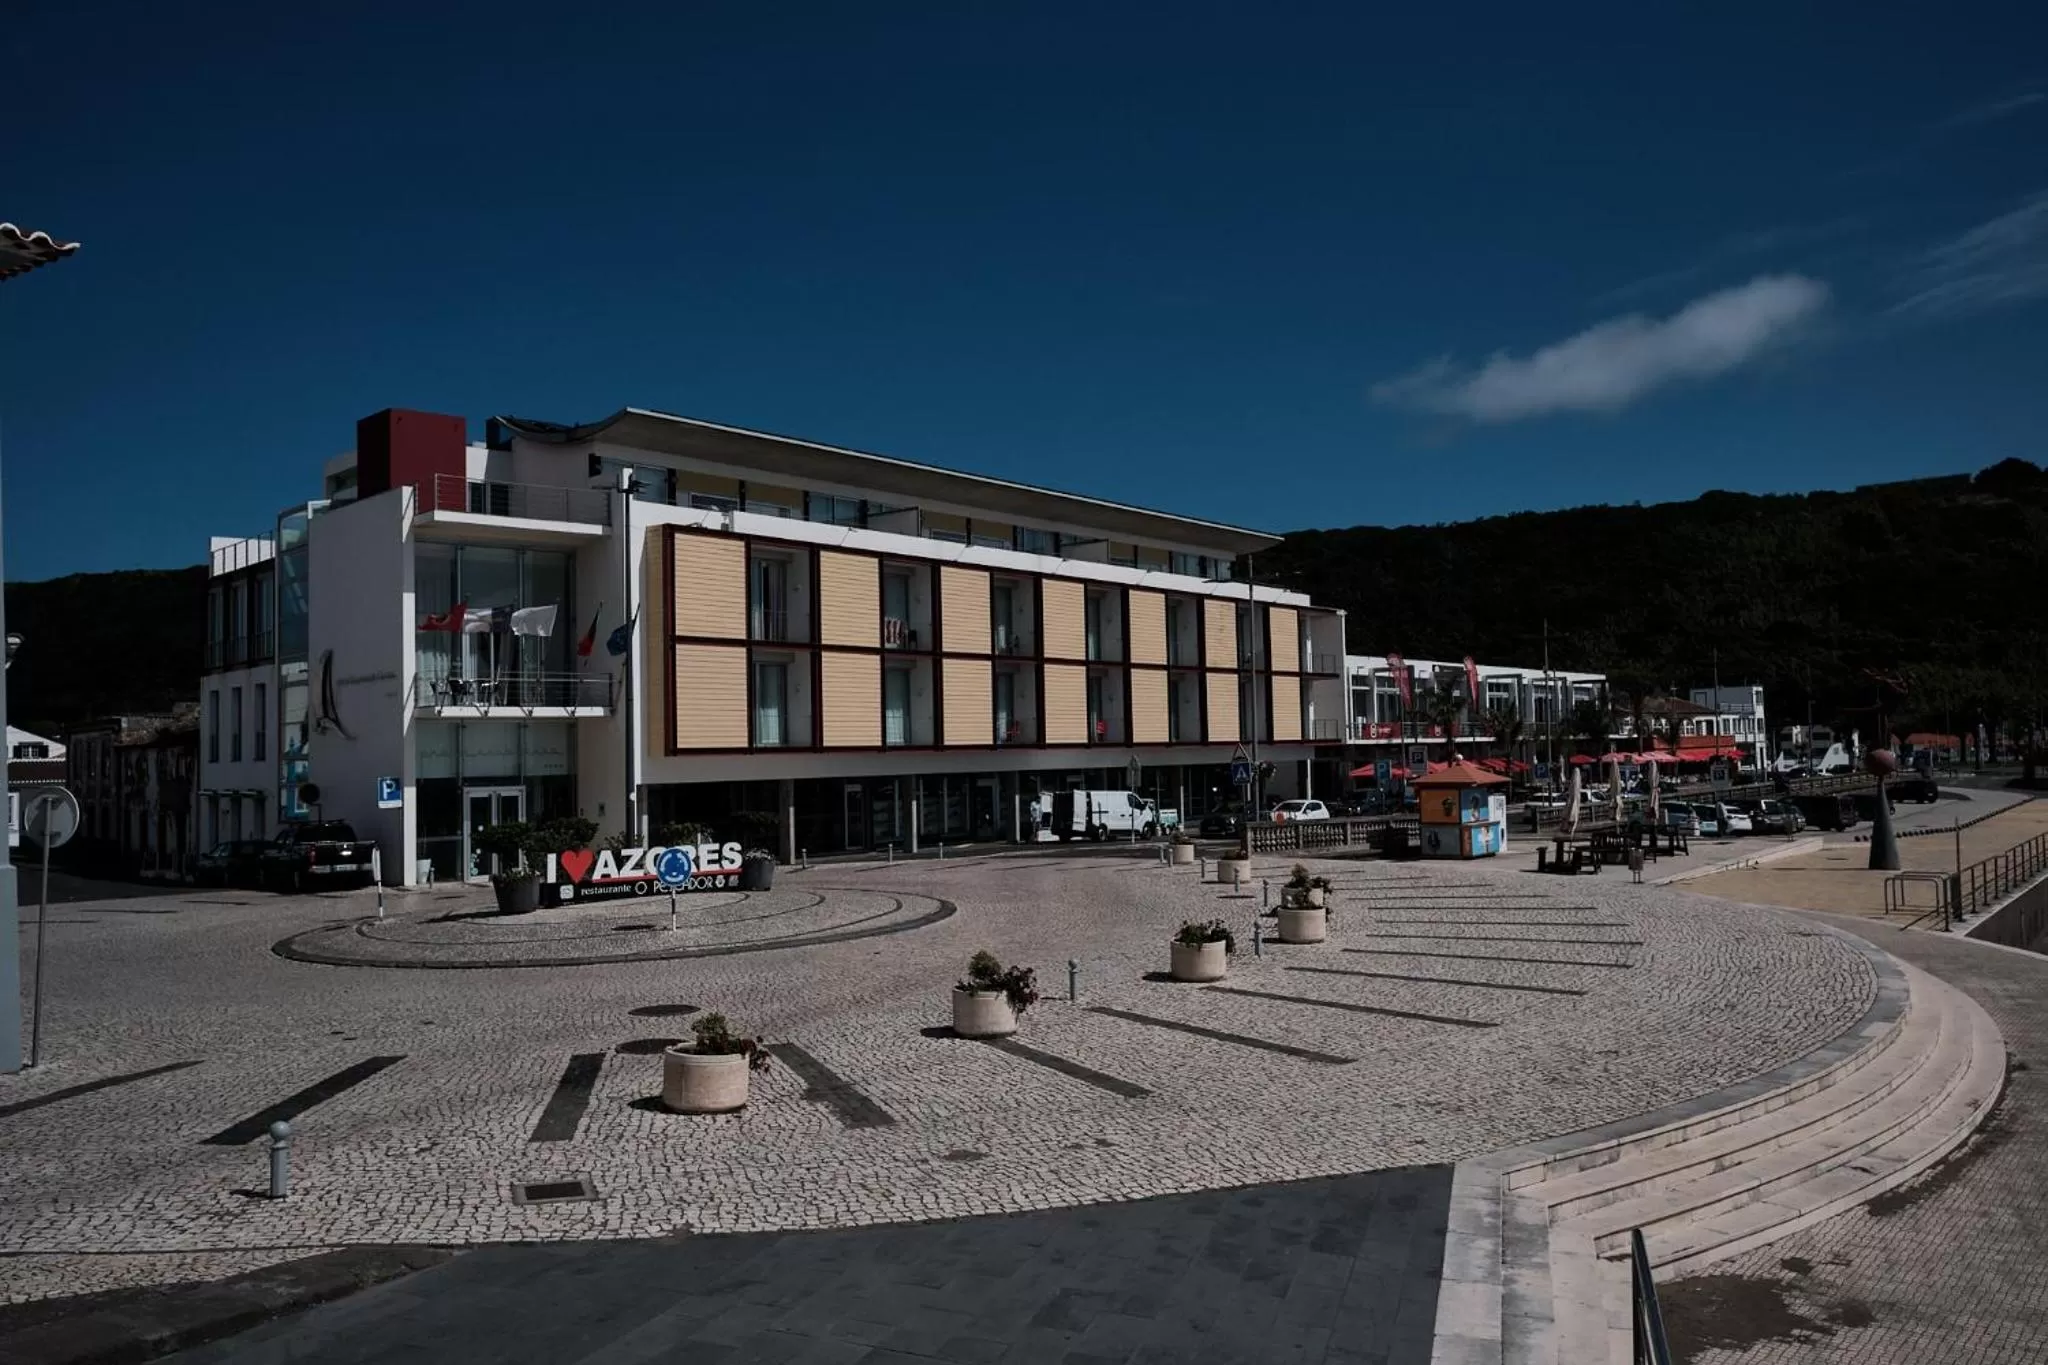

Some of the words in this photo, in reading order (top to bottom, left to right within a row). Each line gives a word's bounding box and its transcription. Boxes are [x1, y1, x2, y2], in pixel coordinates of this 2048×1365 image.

[383, 781, 397, 801] P
[547, 853, 557, 883] I
[580, 884, 632, 896] restaurante
